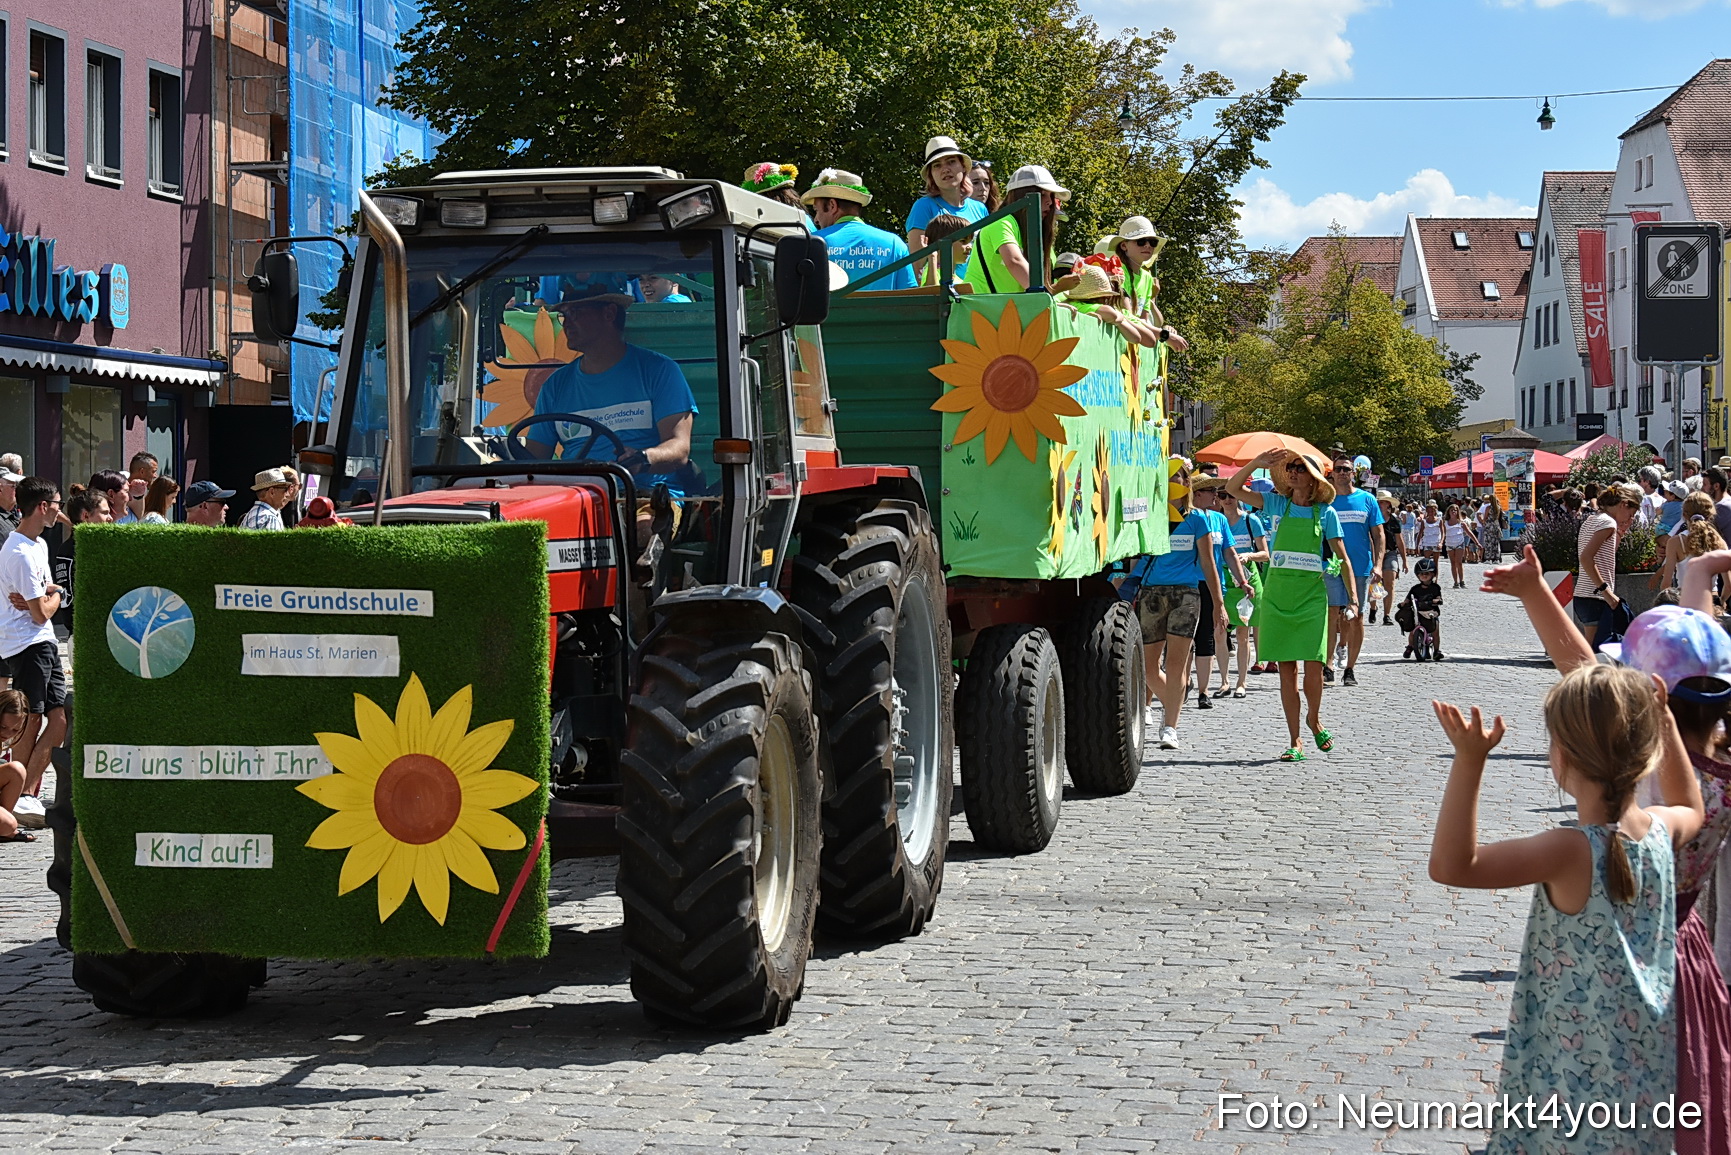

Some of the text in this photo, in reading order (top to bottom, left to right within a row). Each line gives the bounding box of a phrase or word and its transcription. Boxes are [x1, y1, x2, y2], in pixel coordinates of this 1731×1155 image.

[849, 245, 874, 256] blüht
[877, 246, 891, 257] ihr
[858, 258, 875, 269] auf
[1661, 283, 1694, 295] ZONE
[1584, 281, 1605, 339] SALE
[604, 408, 645, 420] Grundschule
[558, 547, 581, 563] MASSEY
[223, 588, 418, 612] Freie Grundschule
[250, 645, 377, 660] im Haus St. Marien
[95, 749, 318, 775] Bei uns blüht Ihr
[150, 837, 260, 864] Kind auf!
